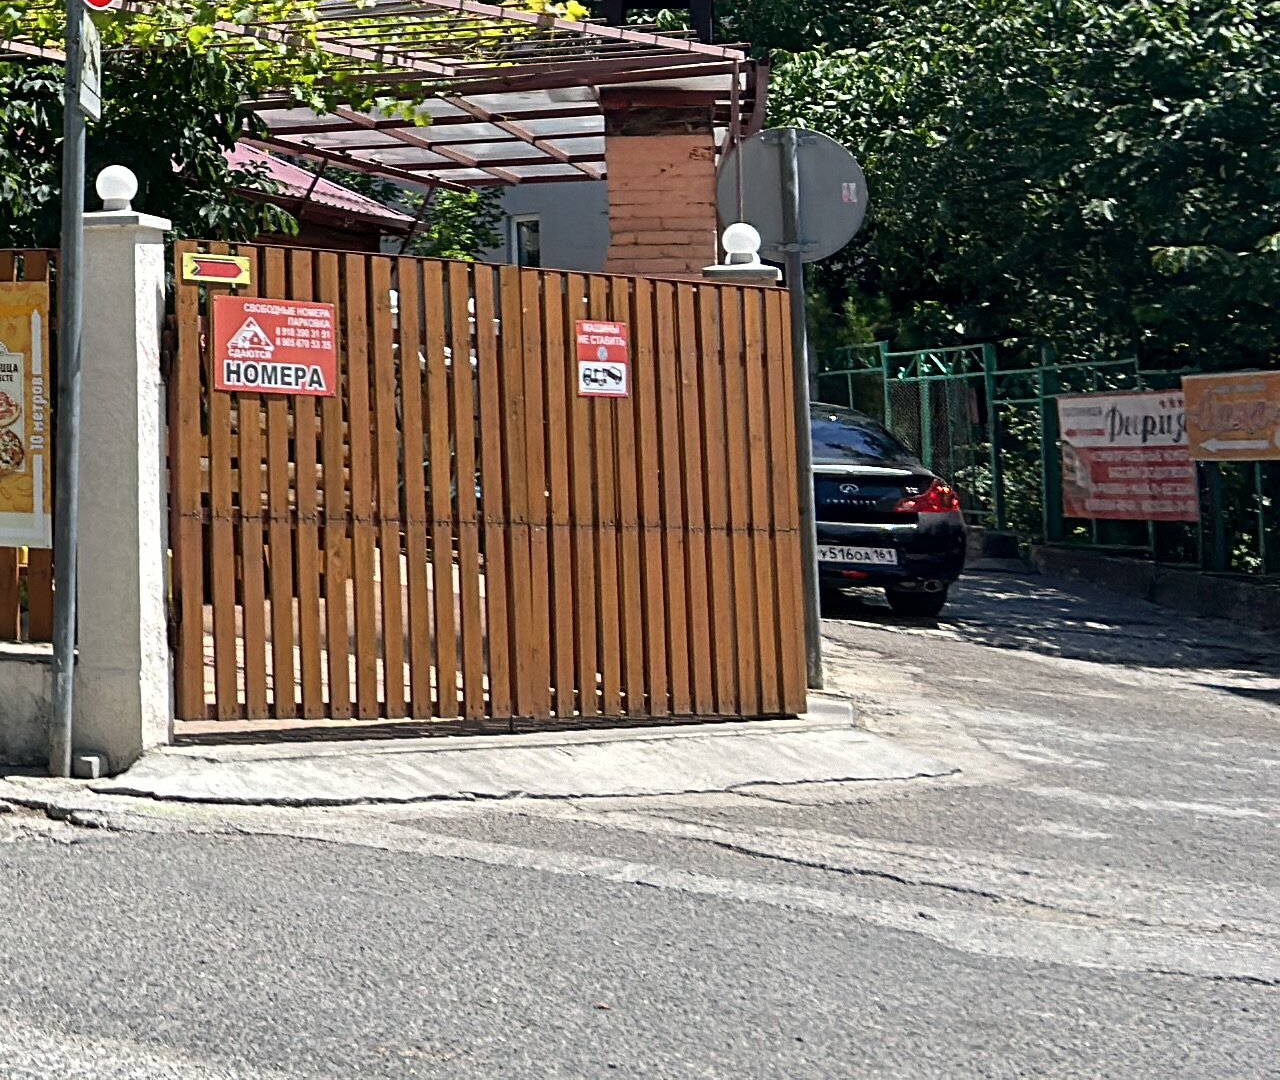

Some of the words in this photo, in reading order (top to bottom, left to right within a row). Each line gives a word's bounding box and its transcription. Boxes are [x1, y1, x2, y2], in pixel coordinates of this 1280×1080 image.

[228, 348, 272, 359] СДАЮТСЯ
[225, 361, 325, 390] НОМЕРА
[32, 376, 48, 432] метров
[30, 435, 44, 450] 10
